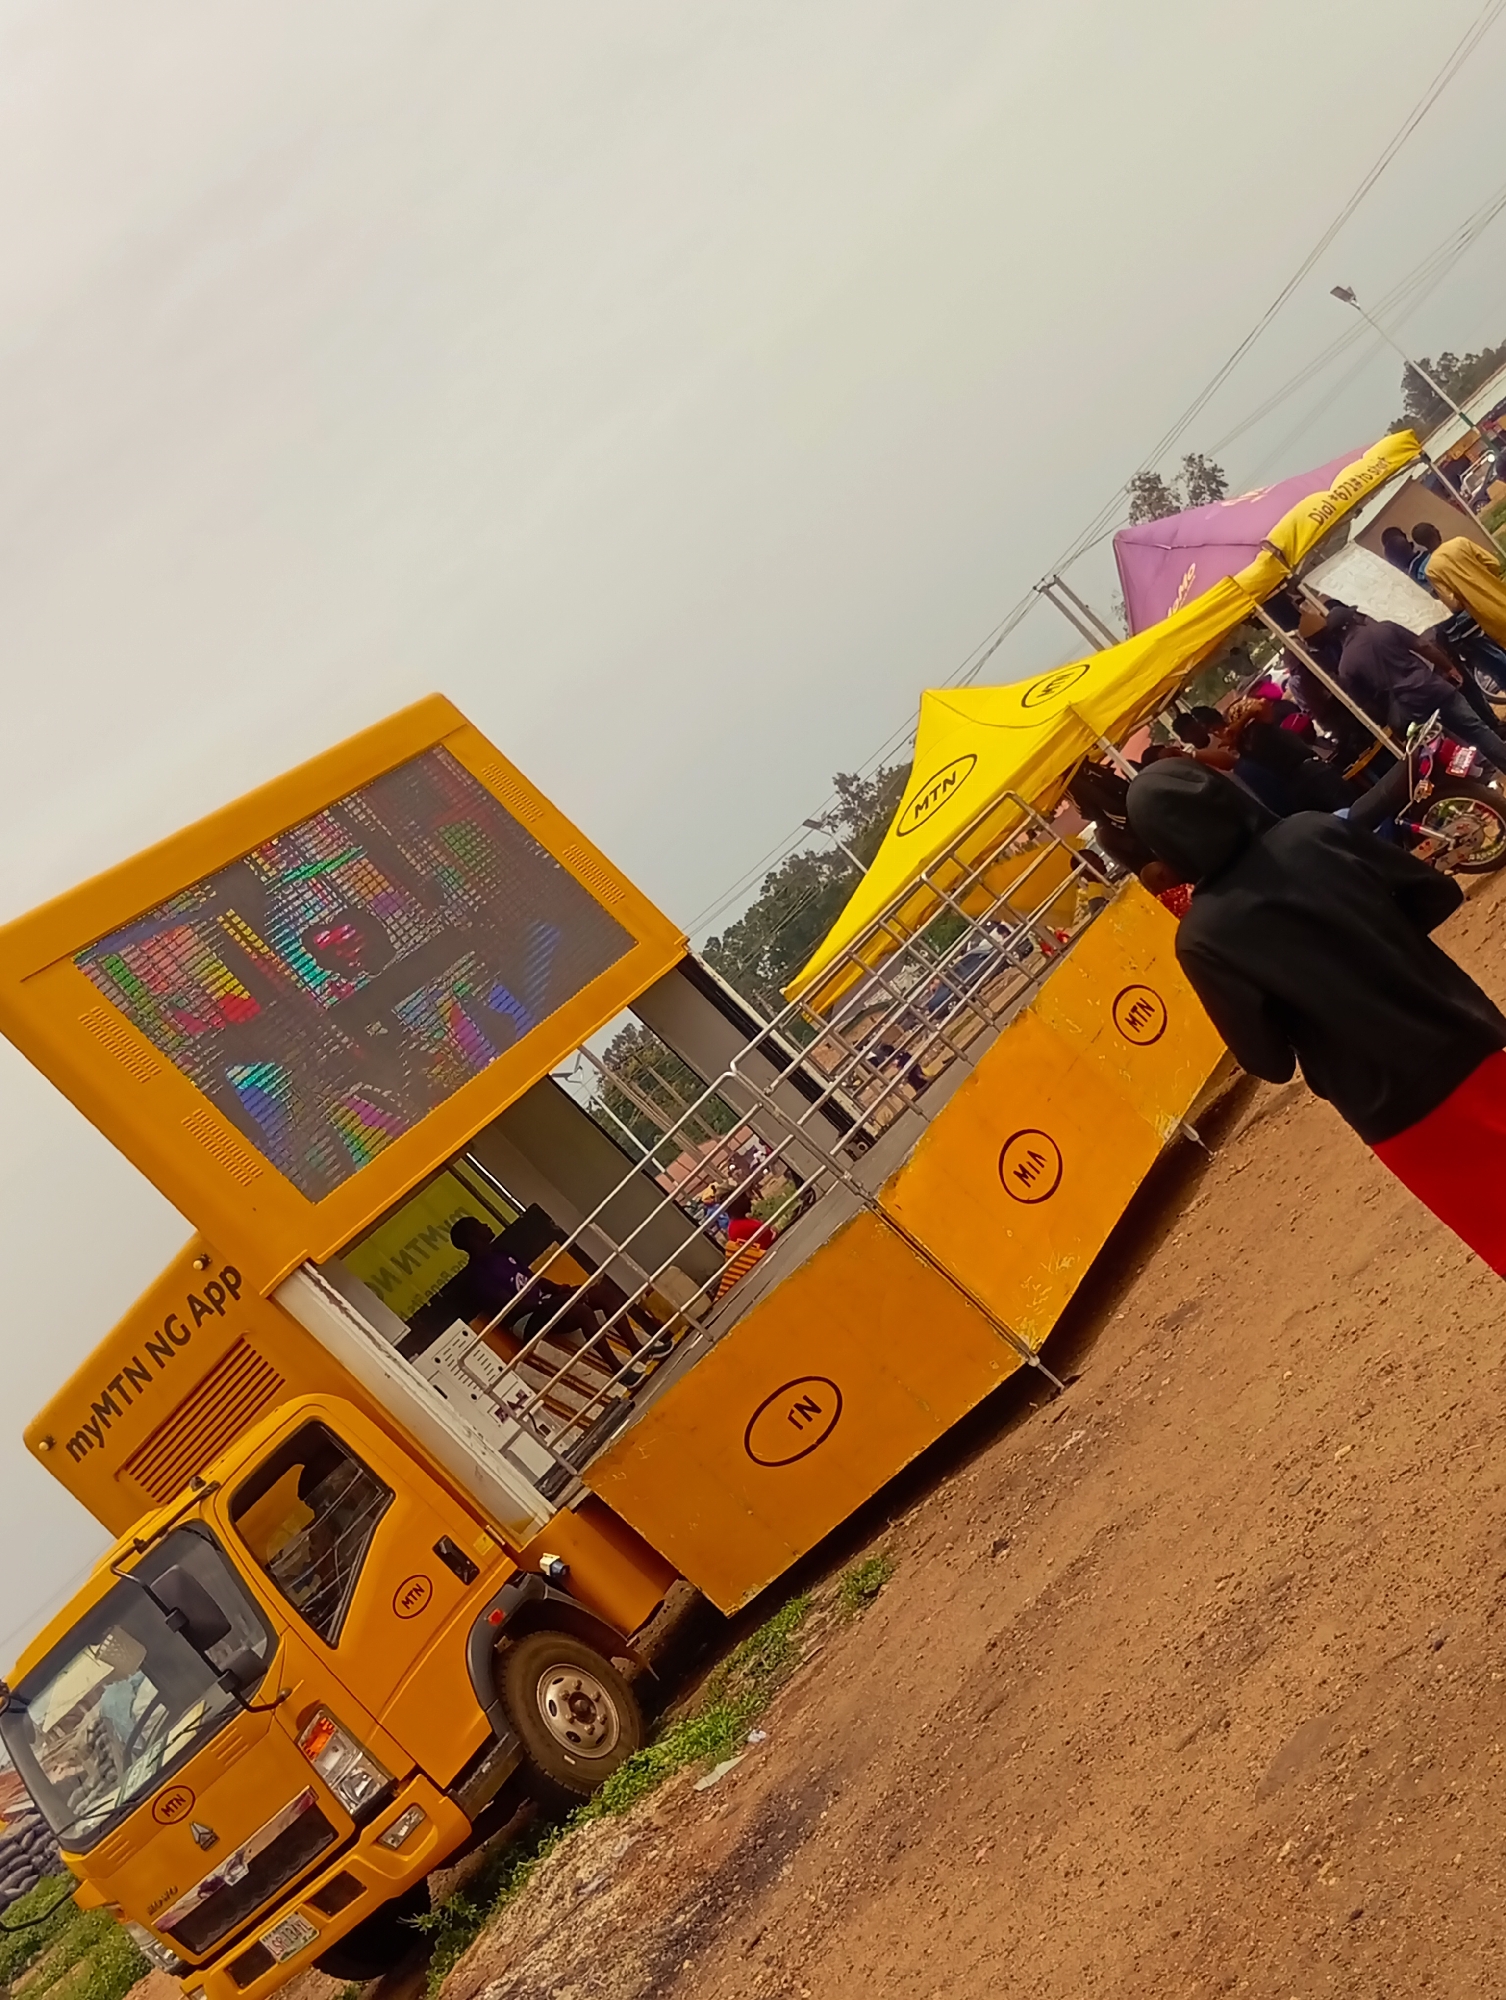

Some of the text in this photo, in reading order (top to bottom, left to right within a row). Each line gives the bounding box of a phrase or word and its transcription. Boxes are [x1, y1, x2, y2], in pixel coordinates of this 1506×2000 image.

[1308, 499, 1337, 526] Dial
[914, 770, 957, 820] MTN
[1124, 997, 1155, 1033] MTN
[65, 1265, 242, 1464] myMTN NG App
[401, 1582, 426, 1610] MTN
[160, 1793, 187, 1818] MTN
